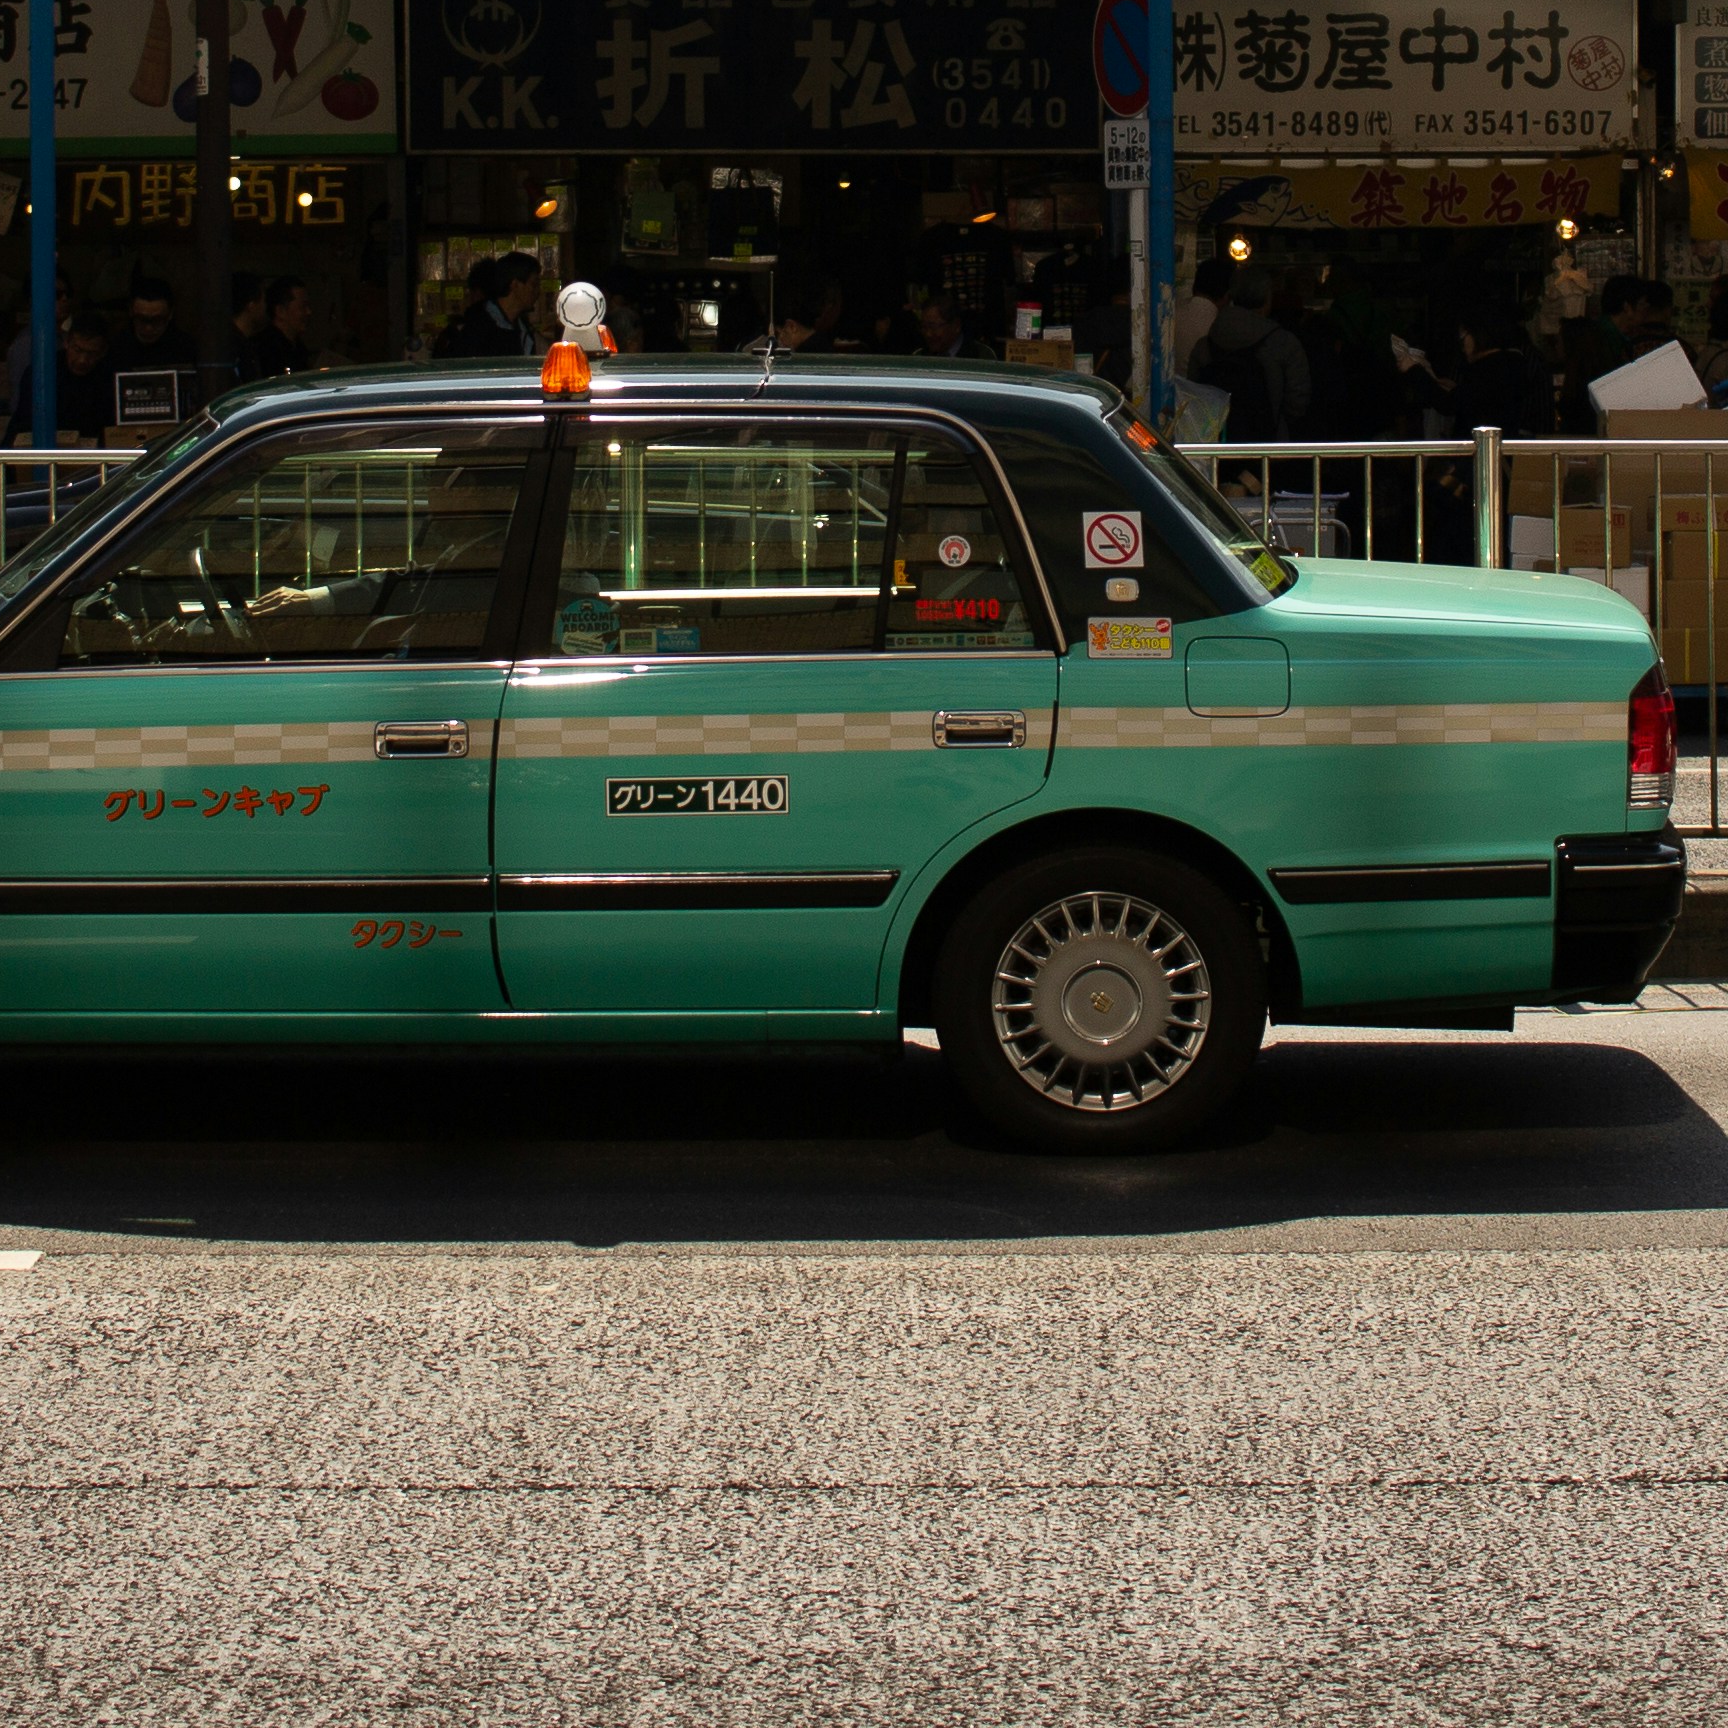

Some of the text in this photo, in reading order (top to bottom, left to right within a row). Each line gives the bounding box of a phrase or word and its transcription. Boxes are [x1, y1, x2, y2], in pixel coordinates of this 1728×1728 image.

[1172, 8, 1570, 93] 株)菊屋中村
[594, 18, 918, 131] 折松
[930, 57, 1052, 92] (3541)
[442, 73, 561, 130] K.K.
[944, 96, 1067, 130] 0440
[1414, 113, 1454, 134] FAX
[1463, 109, 1613, 137] 3541-6307
[70, 162, 349, 234] 内野商店
[1349, 166, 1592, 229] 築地名物
[560, 612, 615, 623] WELCOME
[563, 622, 614, 633] ABOARD!
[1110, 624, 1156, 637] タクシー
[103, 783, 331, 822] グリーンキャブ
[350, 918, 463, 950] タクシー
